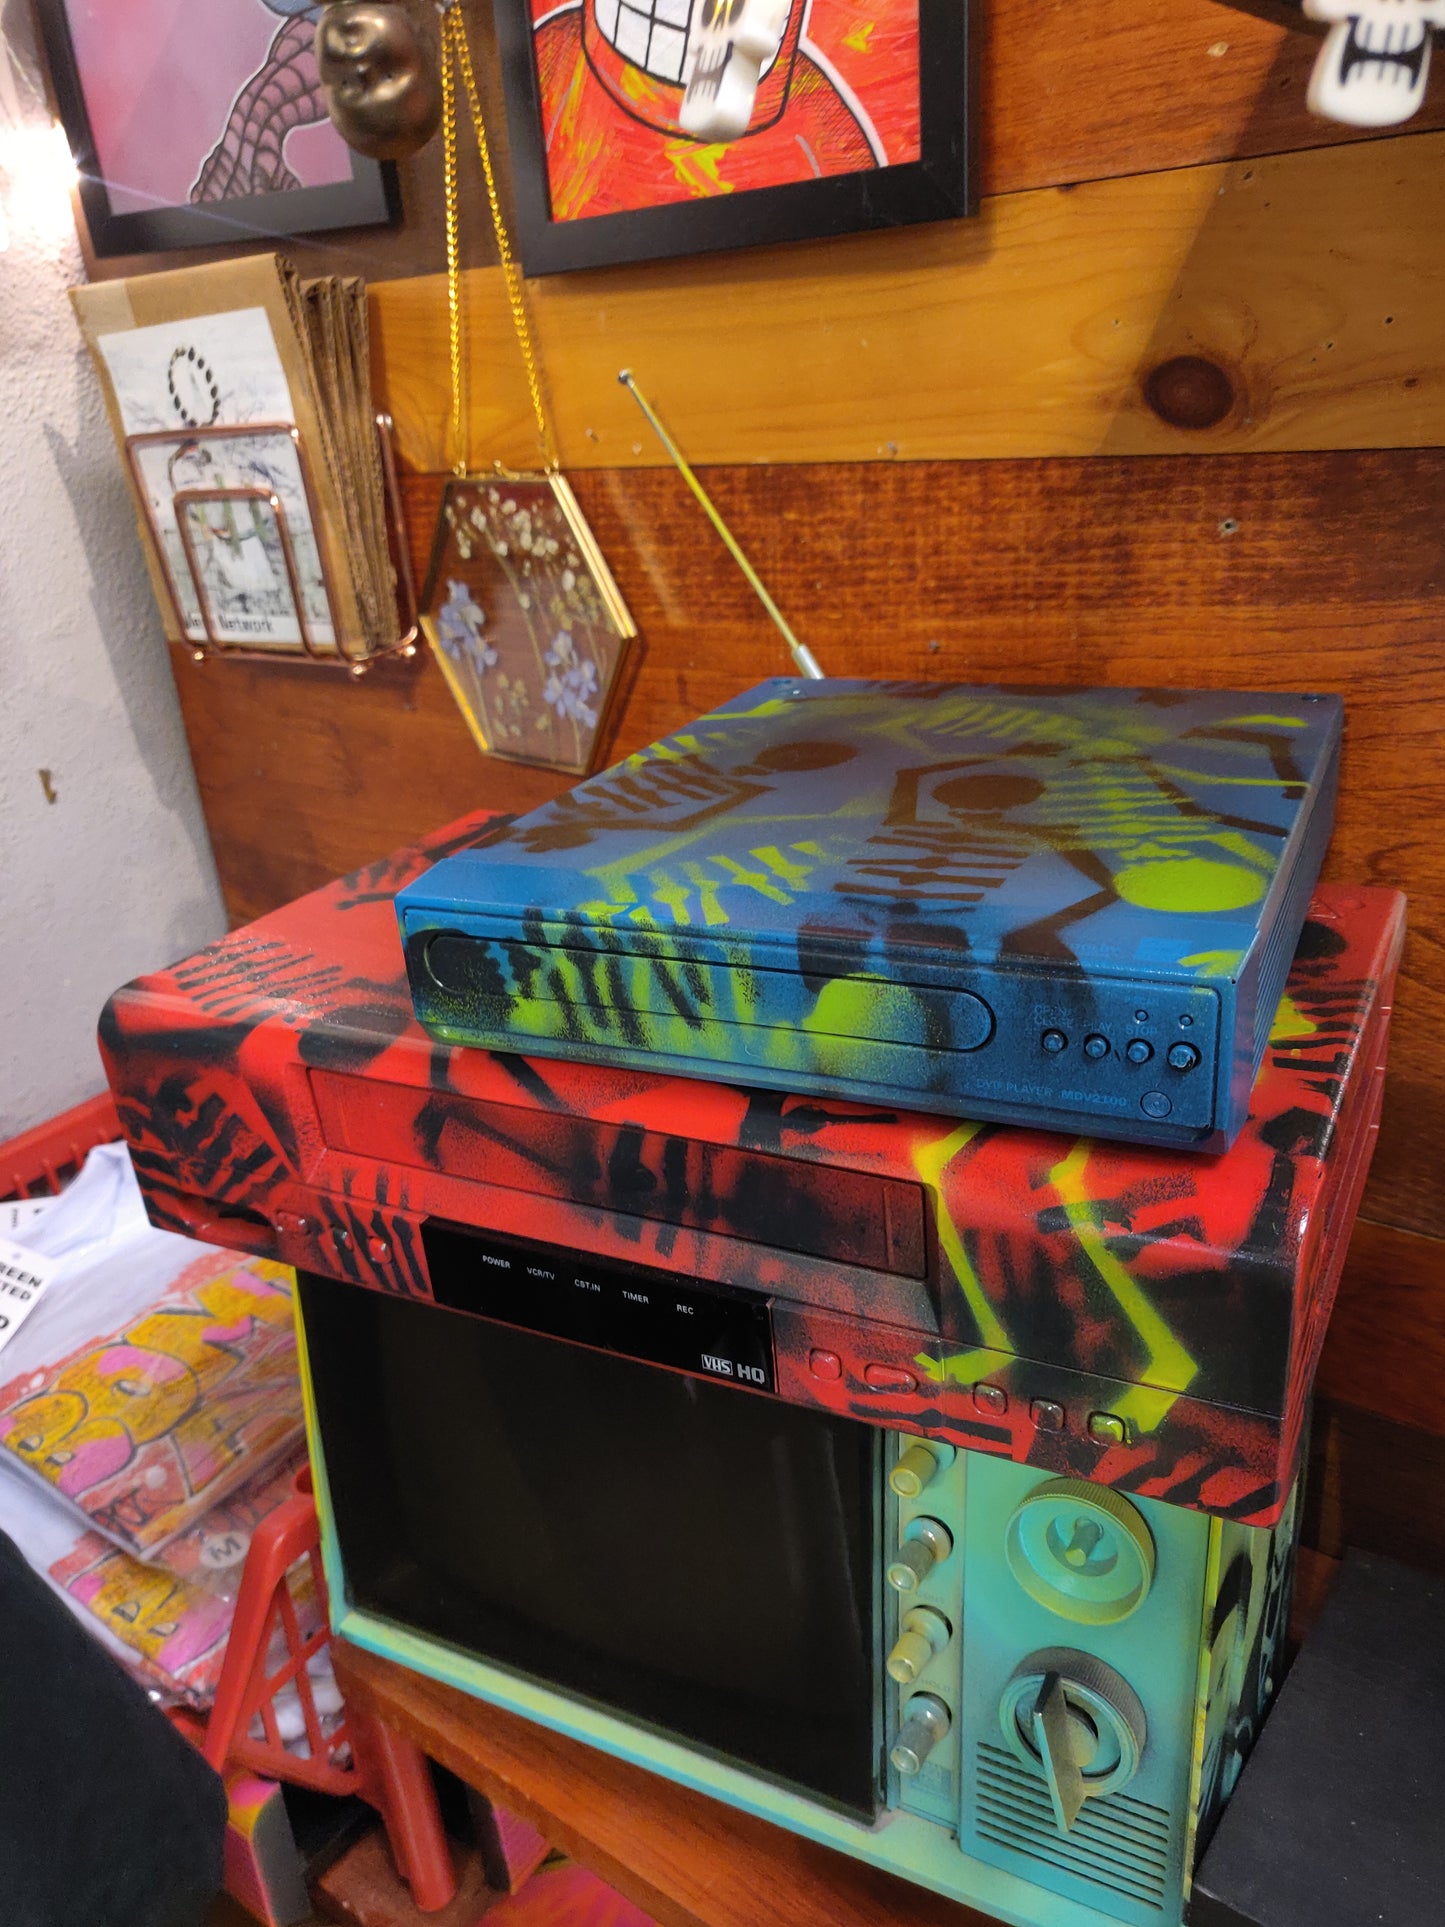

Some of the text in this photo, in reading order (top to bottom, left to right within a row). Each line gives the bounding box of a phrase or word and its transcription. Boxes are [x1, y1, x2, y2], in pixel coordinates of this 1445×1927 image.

[482, 1254, 511, 1269] POWER
[526, 1267, 555, 1280] VCR/TV
[574, 1278, 601, 1292] CST.IN
[622, 1290, 649, 1304] TIMER
[676, 1303, 694, 1315] REC
[702, 1354, 765, 1385] VHS HQ
